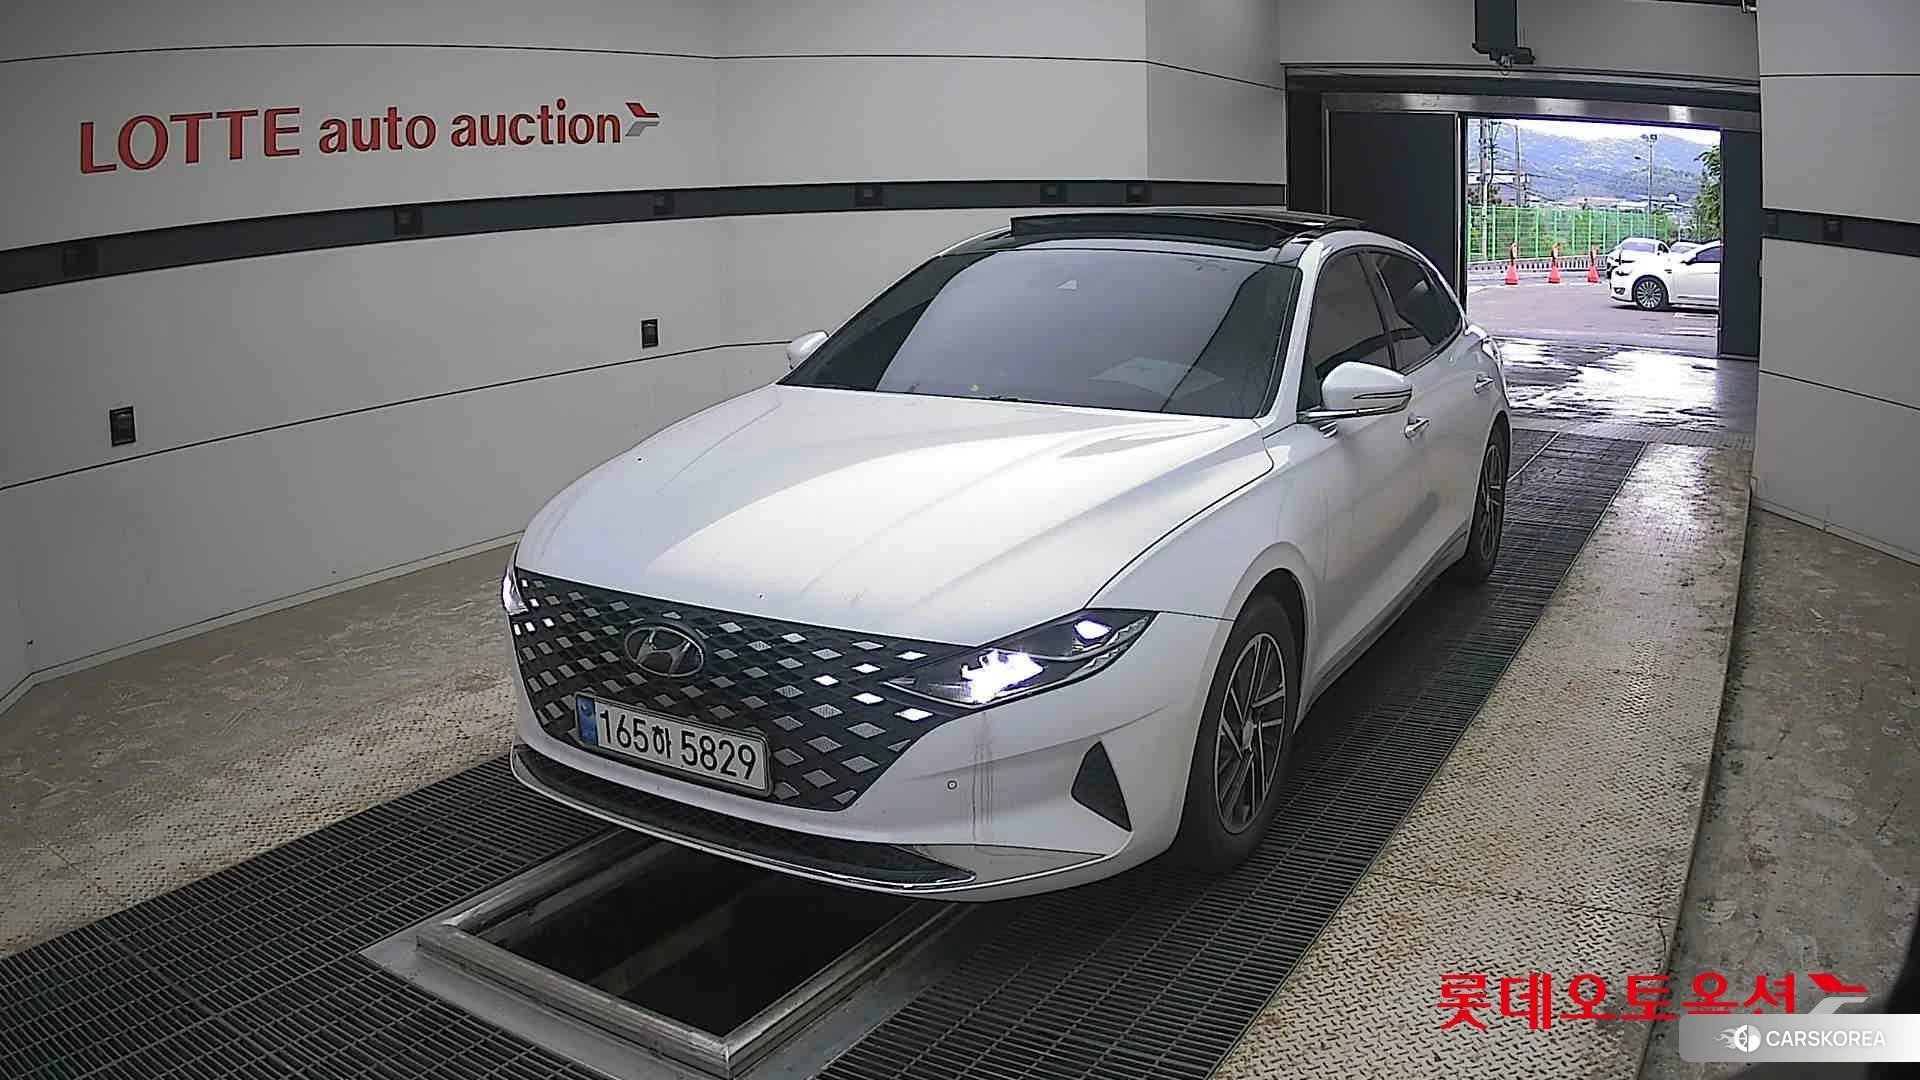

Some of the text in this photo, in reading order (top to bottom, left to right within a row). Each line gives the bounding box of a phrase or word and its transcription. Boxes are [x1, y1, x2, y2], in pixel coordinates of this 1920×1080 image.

[80, 98, 621, 174] LOTTE auto auction
[600, 709, 756, 780] 165하 5829
